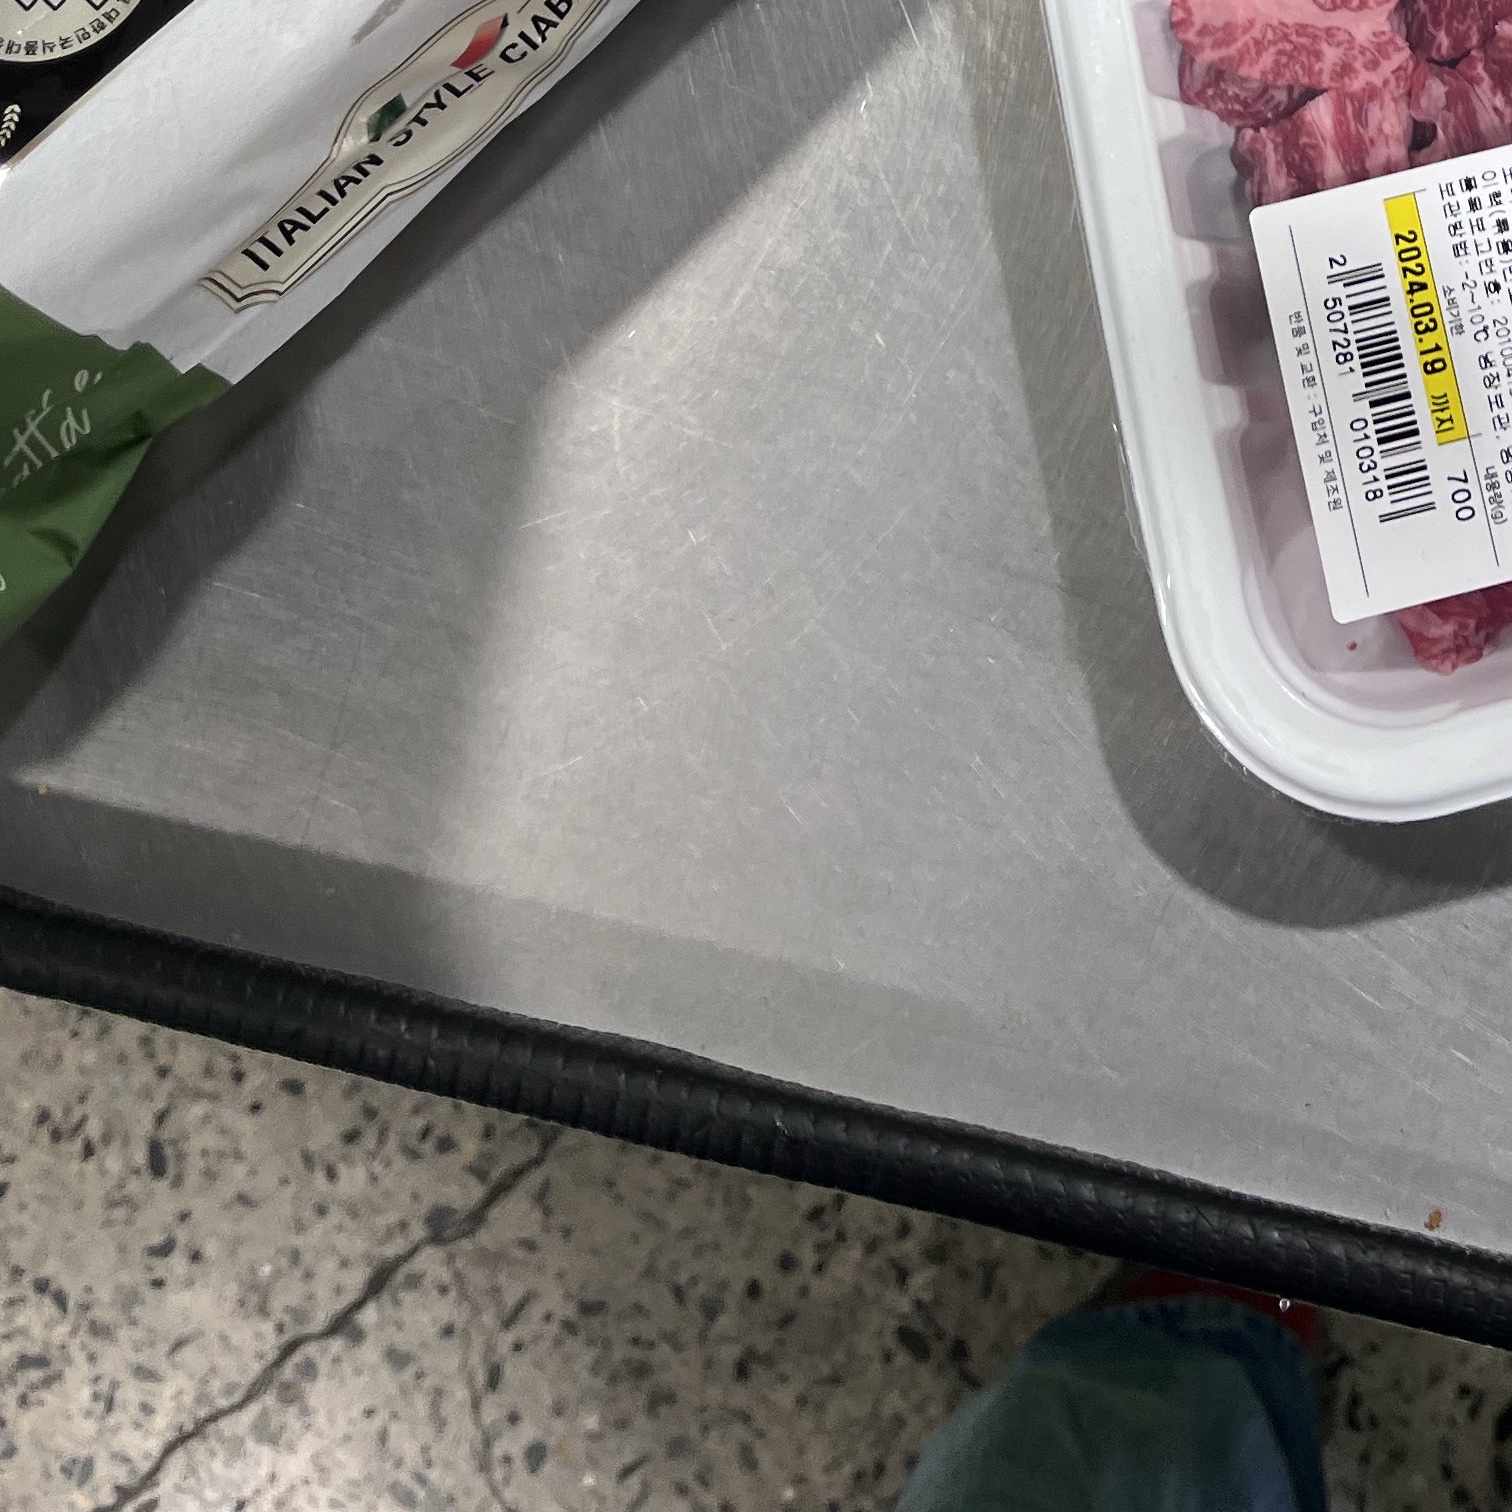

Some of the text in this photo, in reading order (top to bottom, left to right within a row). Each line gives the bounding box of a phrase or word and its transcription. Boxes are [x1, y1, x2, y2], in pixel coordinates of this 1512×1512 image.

[241, 153, 385, 273] ITALIAN
[389, 62, 497, 150] STYLE
[1439, 183, 1468, 263] 보관방법:
[1394, 230, 1454, 434] 2024.03.19 까지
[1442, 286, 1465, 336] 소비기한
[1324, 255, 1383, 501] 2 507281 010318
[1301, 362, 1317, 388] 교환
[1309, 405, 1329, 446] 구입처
[1324, 469, 1343, 511] 제조원
[1447, 470, 1475, 521] 700
[1484, 466, 1507, 524] 내용량(g)
